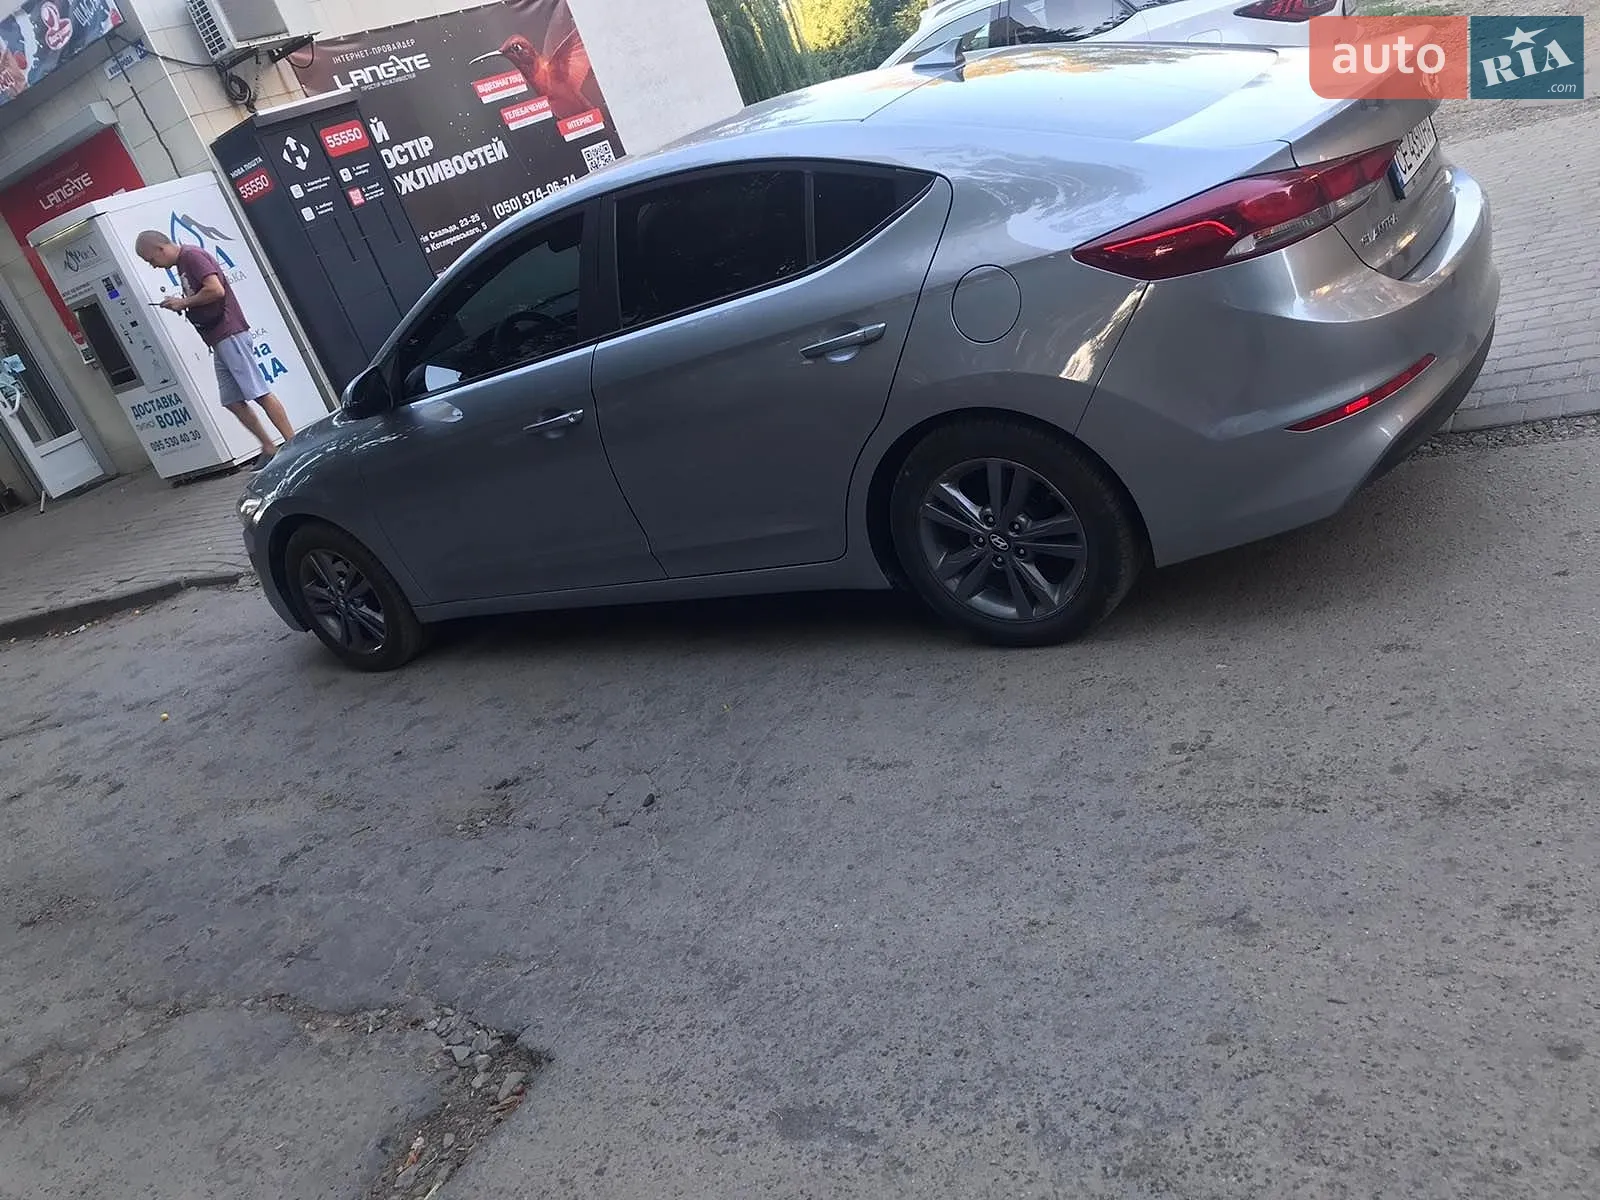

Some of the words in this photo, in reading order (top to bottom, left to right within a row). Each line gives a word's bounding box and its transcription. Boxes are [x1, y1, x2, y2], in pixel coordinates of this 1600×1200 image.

[332, 38, 417, 65] ІНТЕРНЕТ-ПРОВАЙДЕР
[332, 53, 431, 91] LANGATE
[477, 73, 524, 94] ВІДЕОНАГЛЯД
[504, 99, 550, 121] ТЕЛЕБАЧЕННЯ
[566, 113, 594, 130] ІНТЕРНЕТ
[325, 127, 363, 149] 55550
[393, 137, 509, 195] ЖЛИВОСТЕЙ
[39, 171, 94, 210] LANGATE
[239, 173, 270, 199] 55550
[492, 195, 522, 219] (050)
[458, 213, 481, 228] 23-25
[131, 392, 183, 420] ДОСТАВКА
[156, 406, 192, 431] ВОДИ
[150, 438, 165, 452] 095
[164, 434, 180, 448] 530
[178, 431, 190, 444] 40
[189, 428, 202, 441] 30
